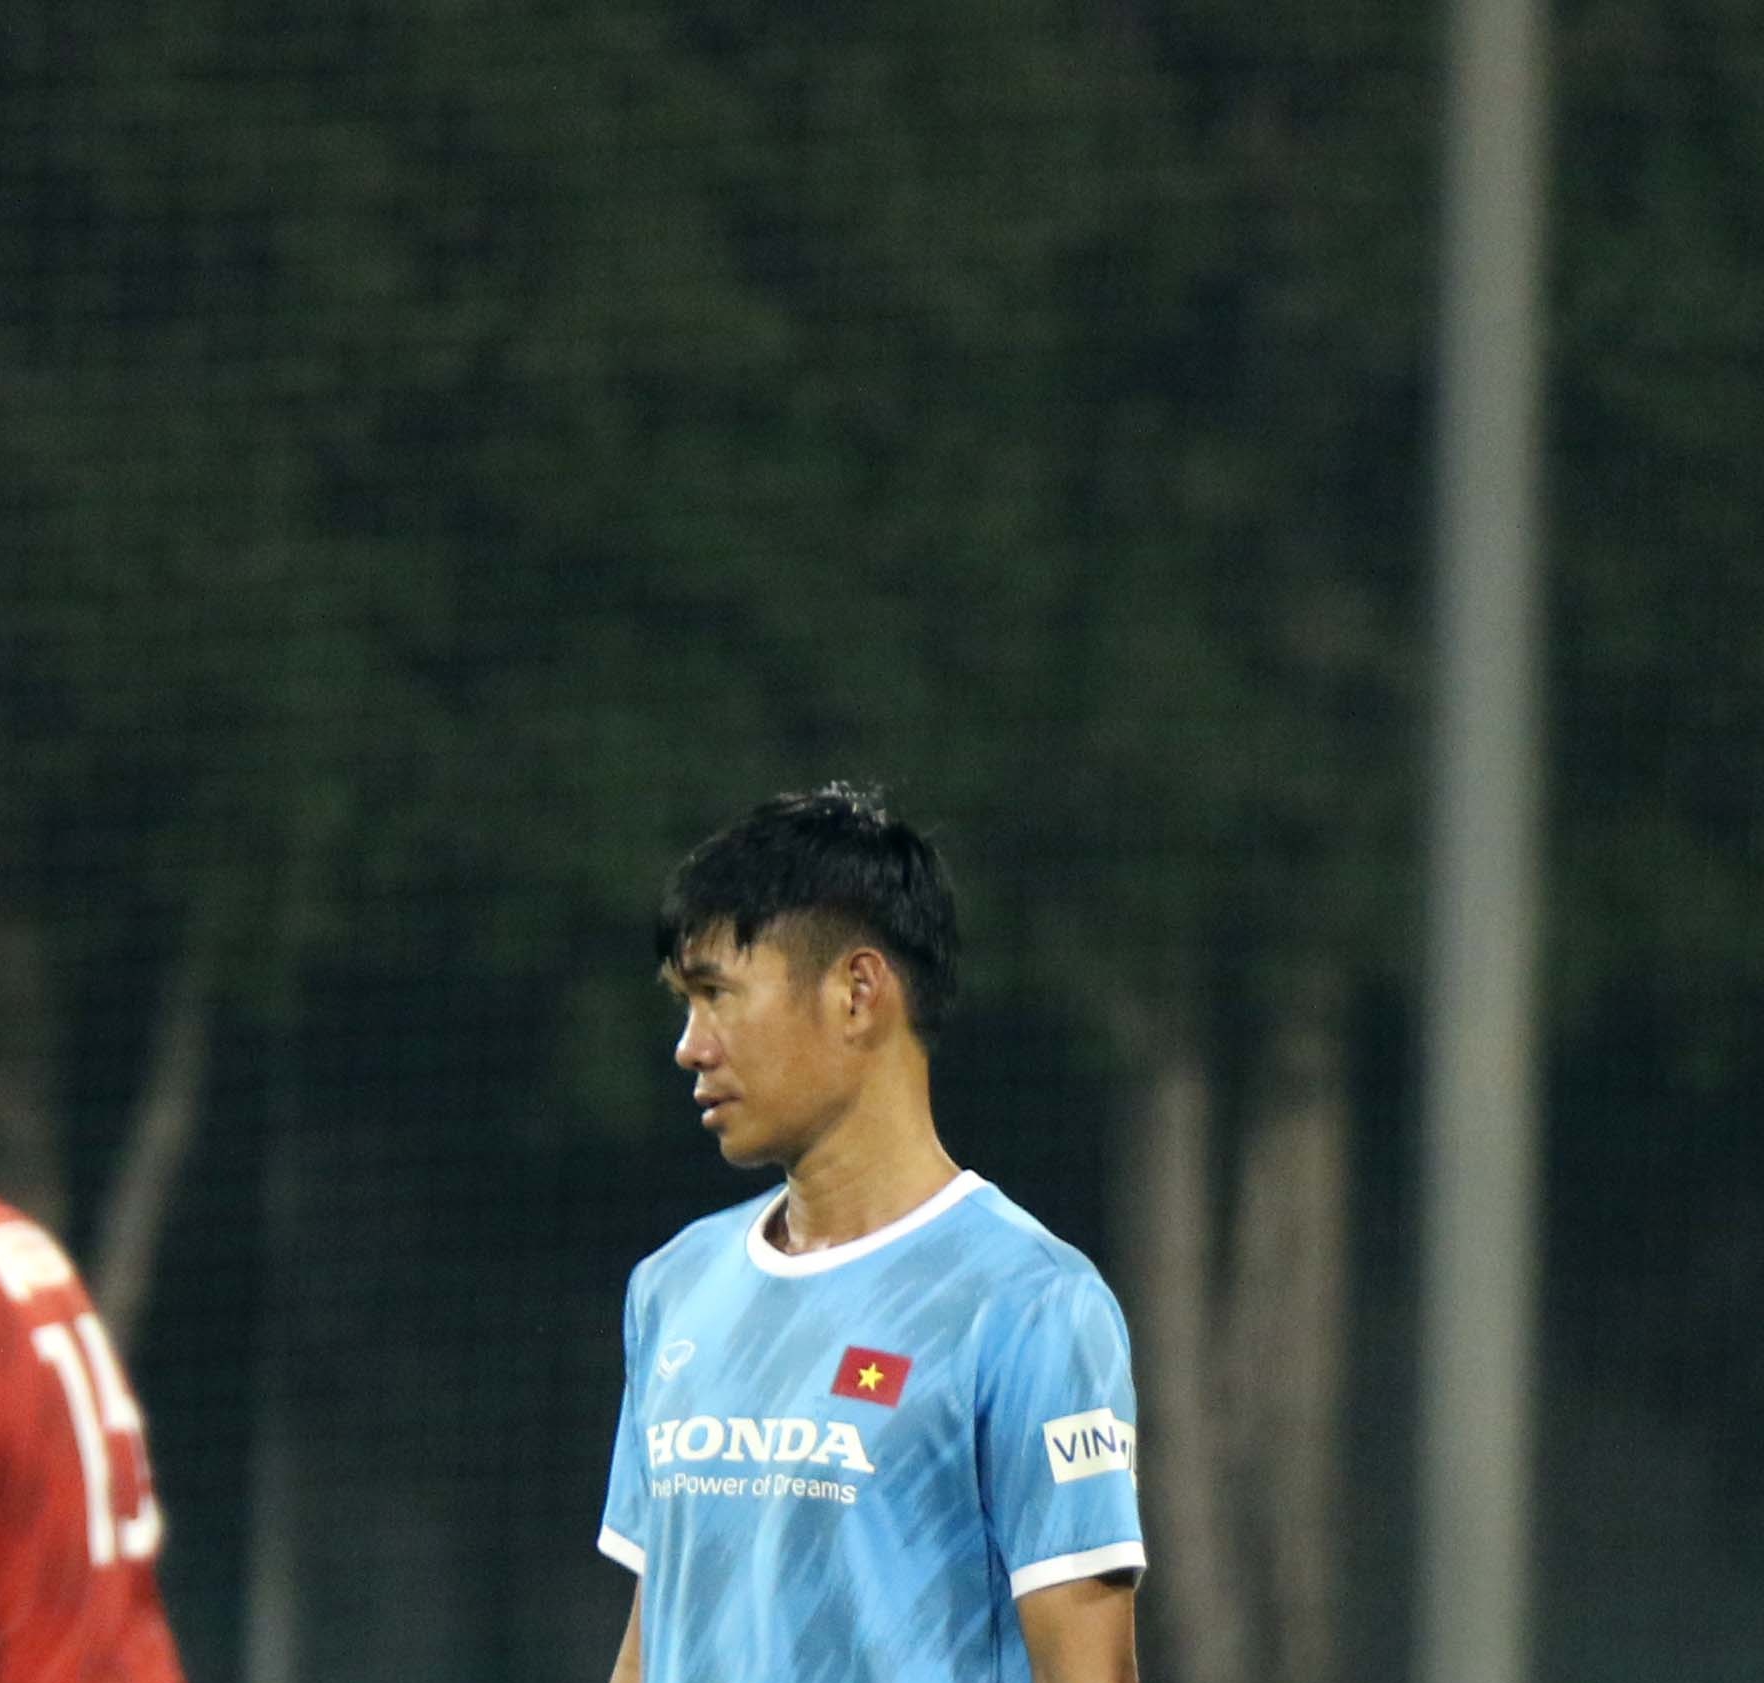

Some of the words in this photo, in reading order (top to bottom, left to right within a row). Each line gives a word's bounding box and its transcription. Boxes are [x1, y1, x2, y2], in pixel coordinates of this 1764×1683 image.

[646, 1415, 876, 1474] HONDA
[1052, 1425, 1129, 1464] VIN
[651, 1478, 672, 1499] he
[674, 1472, 748, 1497] Power
[751, 1473, 773, 1497] of
[773, 1473, 858, 1505] Dreams
